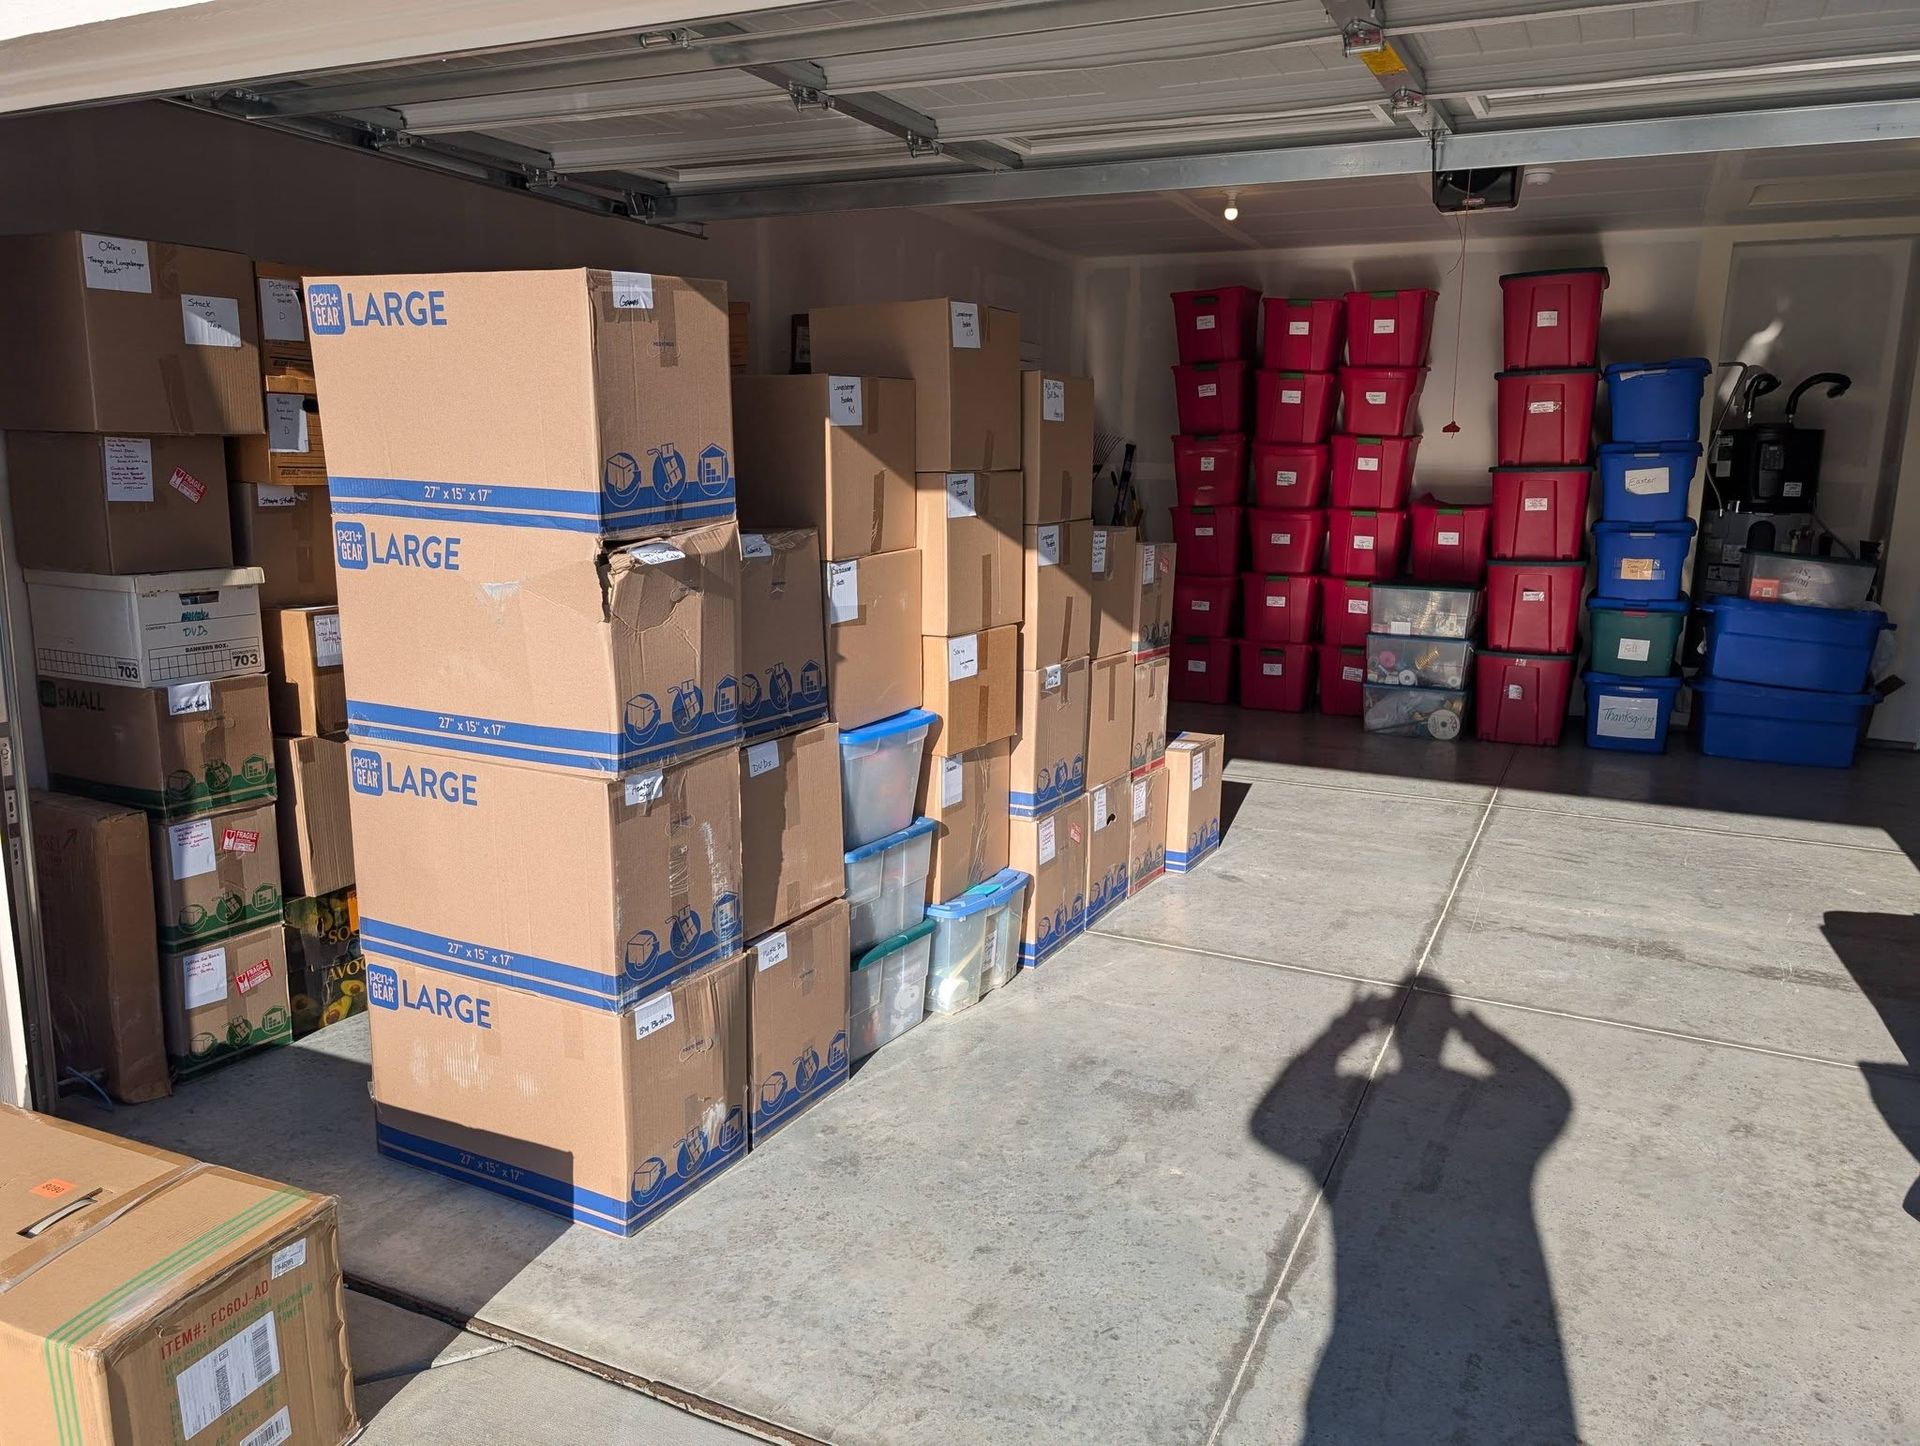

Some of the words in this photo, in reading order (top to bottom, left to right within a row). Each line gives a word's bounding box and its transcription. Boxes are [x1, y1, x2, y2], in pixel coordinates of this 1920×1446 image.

[98, 241, 121, 251] Office
[310, 292, 338, 311] pen+
[348, 290, 447, 326] LARGE
[315, 307, 340, 326] GEAR
[185, 475, 206, 493] FRAGILE
[1629, 478, 1656, 487] Easter
[424, 485, 440, 498] 27"
[443, 490, 449, 499] x
[451, 487, 466, 500] 15"
[469, 492, 475, 501] x
[477, 489, 492, 502] 17"
[337, 529, 362, 546] pen+
[341, 543, 364, 561] GEAR
[370, 532, 461, 570] LARGE
[183, 625, 208, 637] DVDs
[185, 644, 214, 653] BANKERS
[233, 654, 258, 667] 703
[118, 666, 138, 679] 703
[58, 688, 104, 711] SMALL
[438, 717, 454, 729] 27"
[457, 722, 463, 731] x
[465, 720, 480, 733] 15"
[483, 726, 489, 735] x
[491, 723, 506, 736] 17"
[1602, 708, 1655, 730] Thanksgiving
[353, 756, 378, 771] pen+
[356, 769, 378, 788] GEAR
[387, 762, 478, 806] LARGE
[236, 831, 257, 840] FRAGILE
[448, 942, 463, 954] 27"
[466, 949, 472, 958] x
[474, 948, 489, 960] 15"
[491, 955, 498, 963] x
[500, 954, 514, 966] 17"
[246, 961, 268, 977] FRAGILE
[370, 971, 394, 986] pen+
[373, 982, 395, 1003] GEAR
[402, 980, 492, 1029] LARGE
[460, 1153, 475, 1167] 27"
[478, 1161, 483, 1170] x
[486, 1162, 499, 1174] 15"
[502, 1169, 508, 1177] x
[511, 1168, 524, 1181] 17"
[161, 1324, 207, 1360] ITEM#:
[211, 1280, 269, 1326] FC60J-AD
